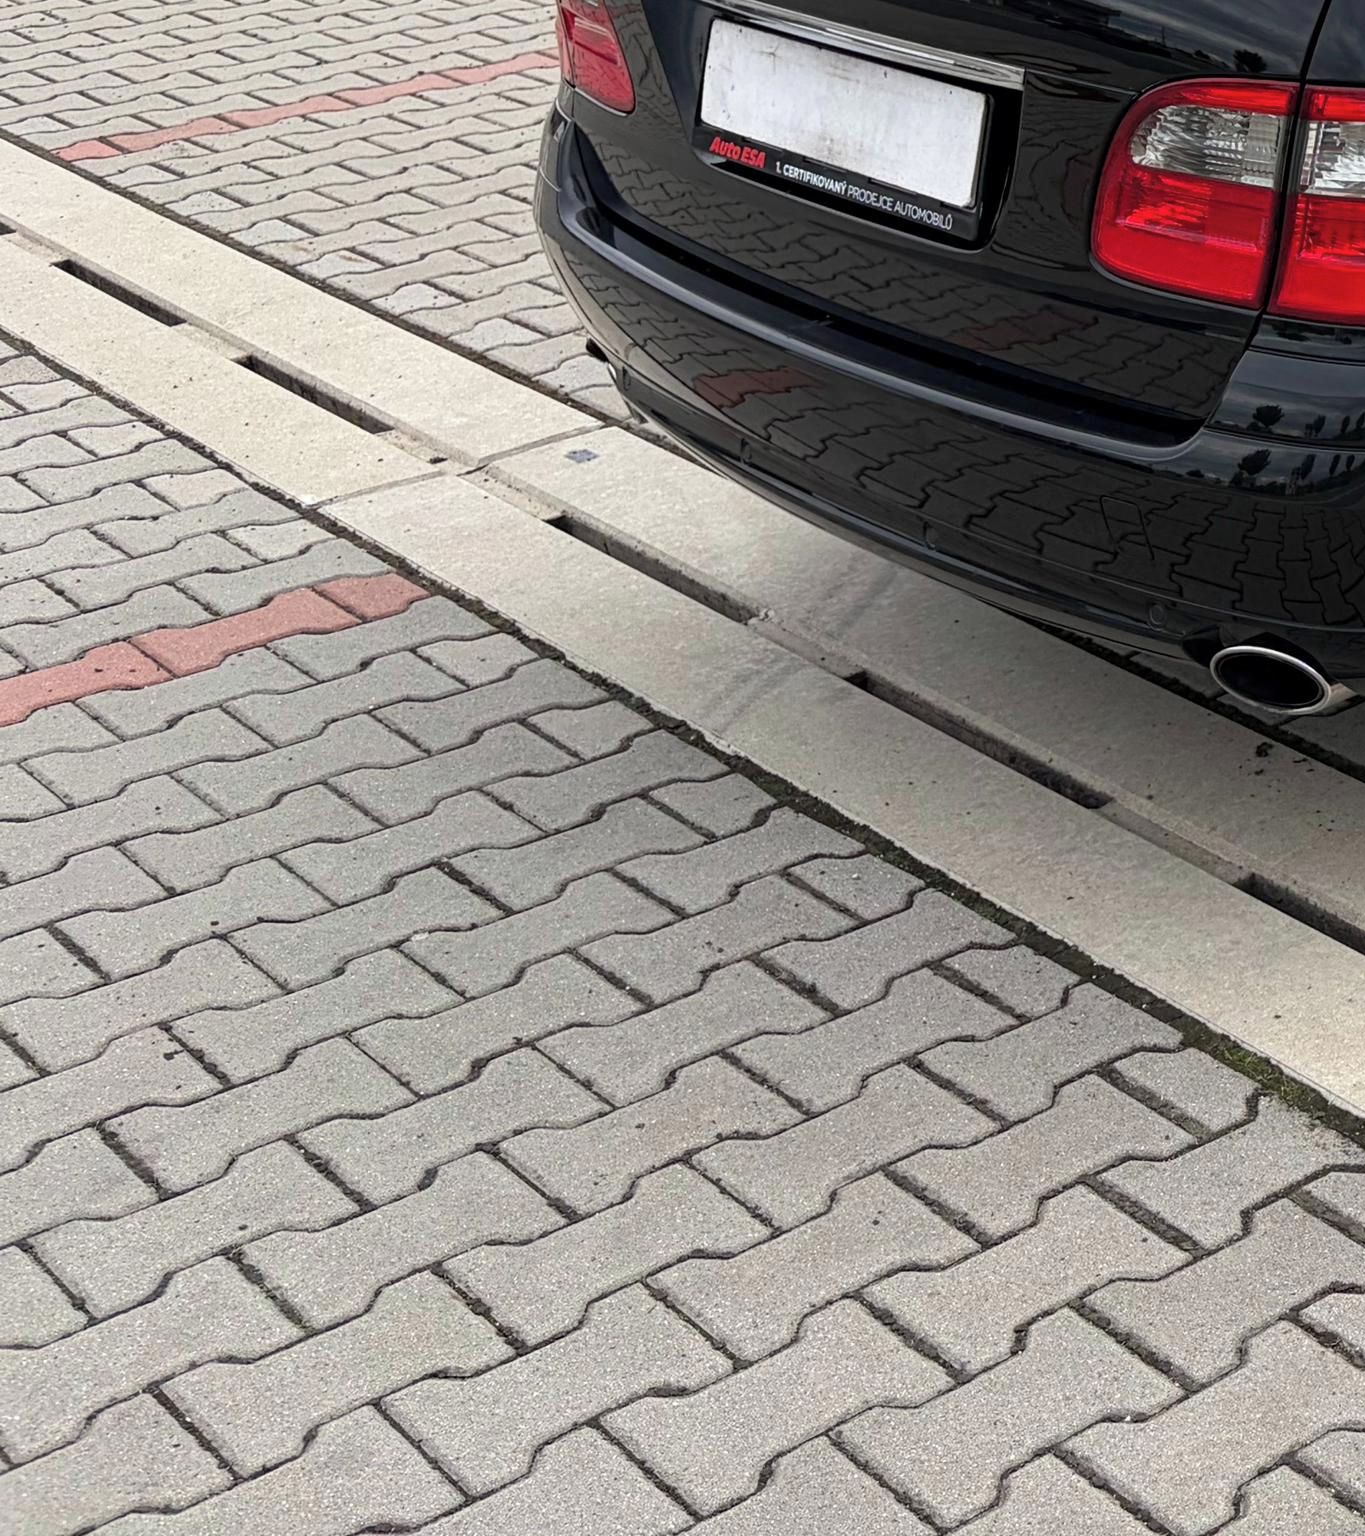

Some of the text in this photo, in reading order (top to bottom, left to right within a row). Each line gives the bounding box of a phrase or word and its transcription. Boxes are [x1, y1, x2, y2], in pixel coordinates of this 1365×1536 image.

[709, 136, 767, 169] Auto ESA
[783, 164, 848, 195] CERTIFIKOVANÝ
[847, 185, 894, 211] PRODEJCE
[893, 200, 953, 230] AUTOMOBILŮ
